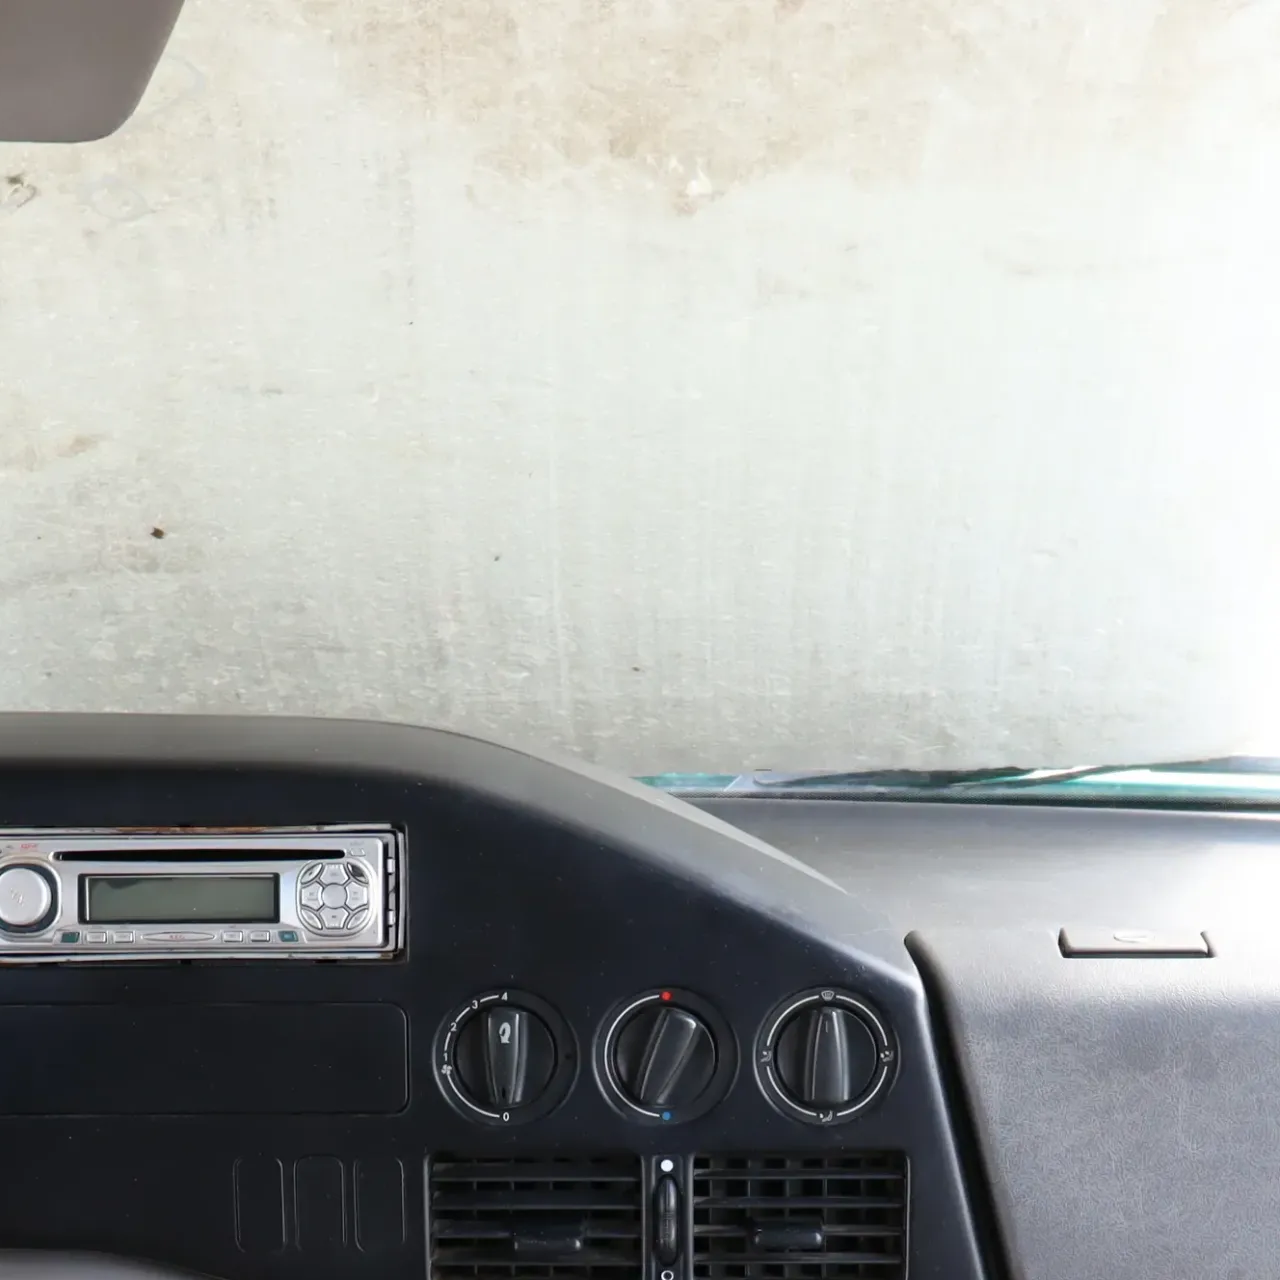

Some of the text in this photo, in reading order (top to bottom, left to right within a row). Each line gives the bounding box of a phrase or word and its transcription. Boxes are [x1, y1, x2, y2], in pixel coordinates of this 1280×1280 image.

[501, 992, 508, 1001] 4
[471, 1000, 478, 1009] 3
[450, 1022, 457, 1031] 2
[443, 1053, 448, 1061] 1
[502, 1112, 509, 1121] 0
